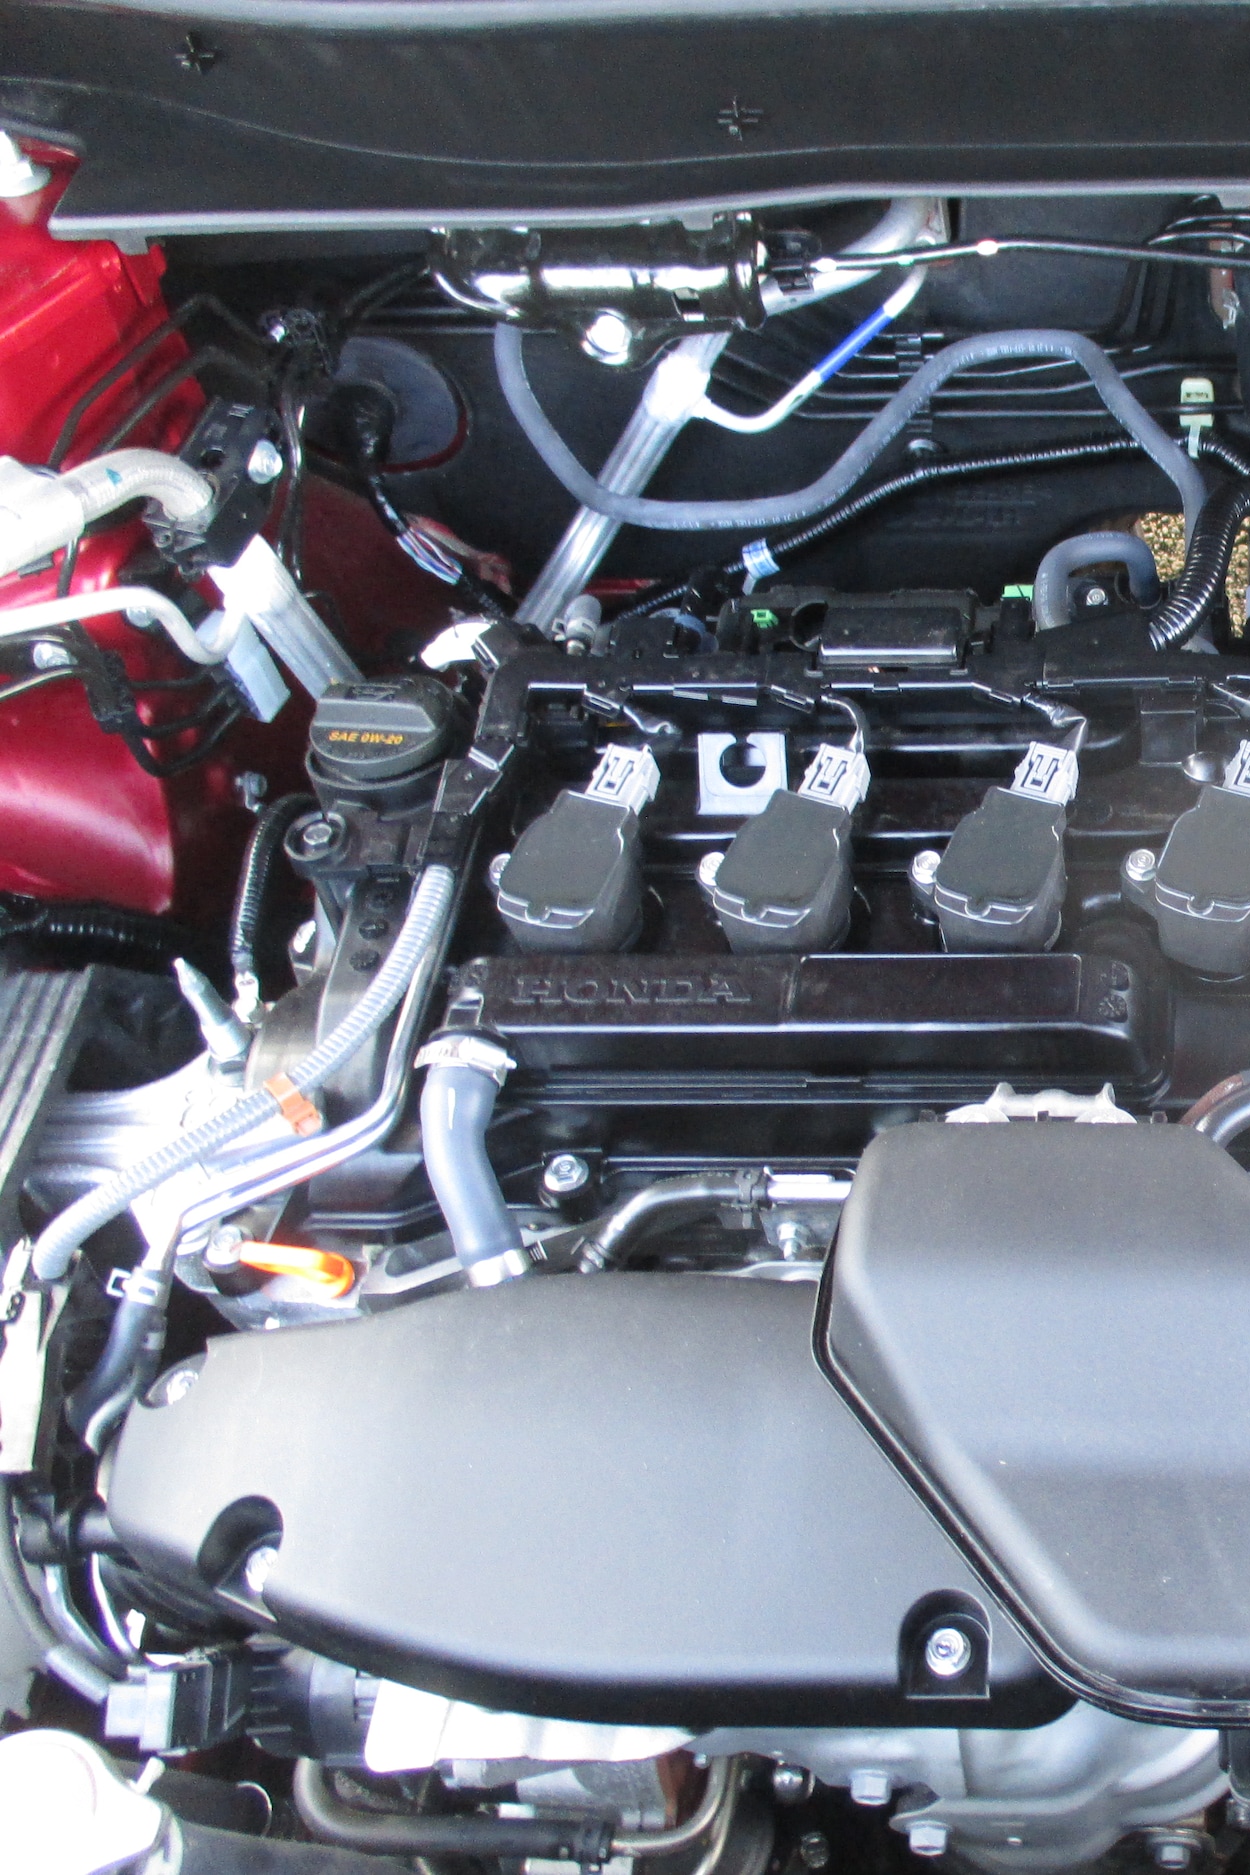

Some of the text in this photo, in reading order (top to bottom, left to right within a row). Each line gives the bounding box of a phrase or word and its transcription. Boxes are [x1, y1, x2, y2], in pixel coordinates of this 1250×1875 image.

[328, 730, 404, 745] SAE 0W-20
[510, 974, 751, 1004] HONDA
